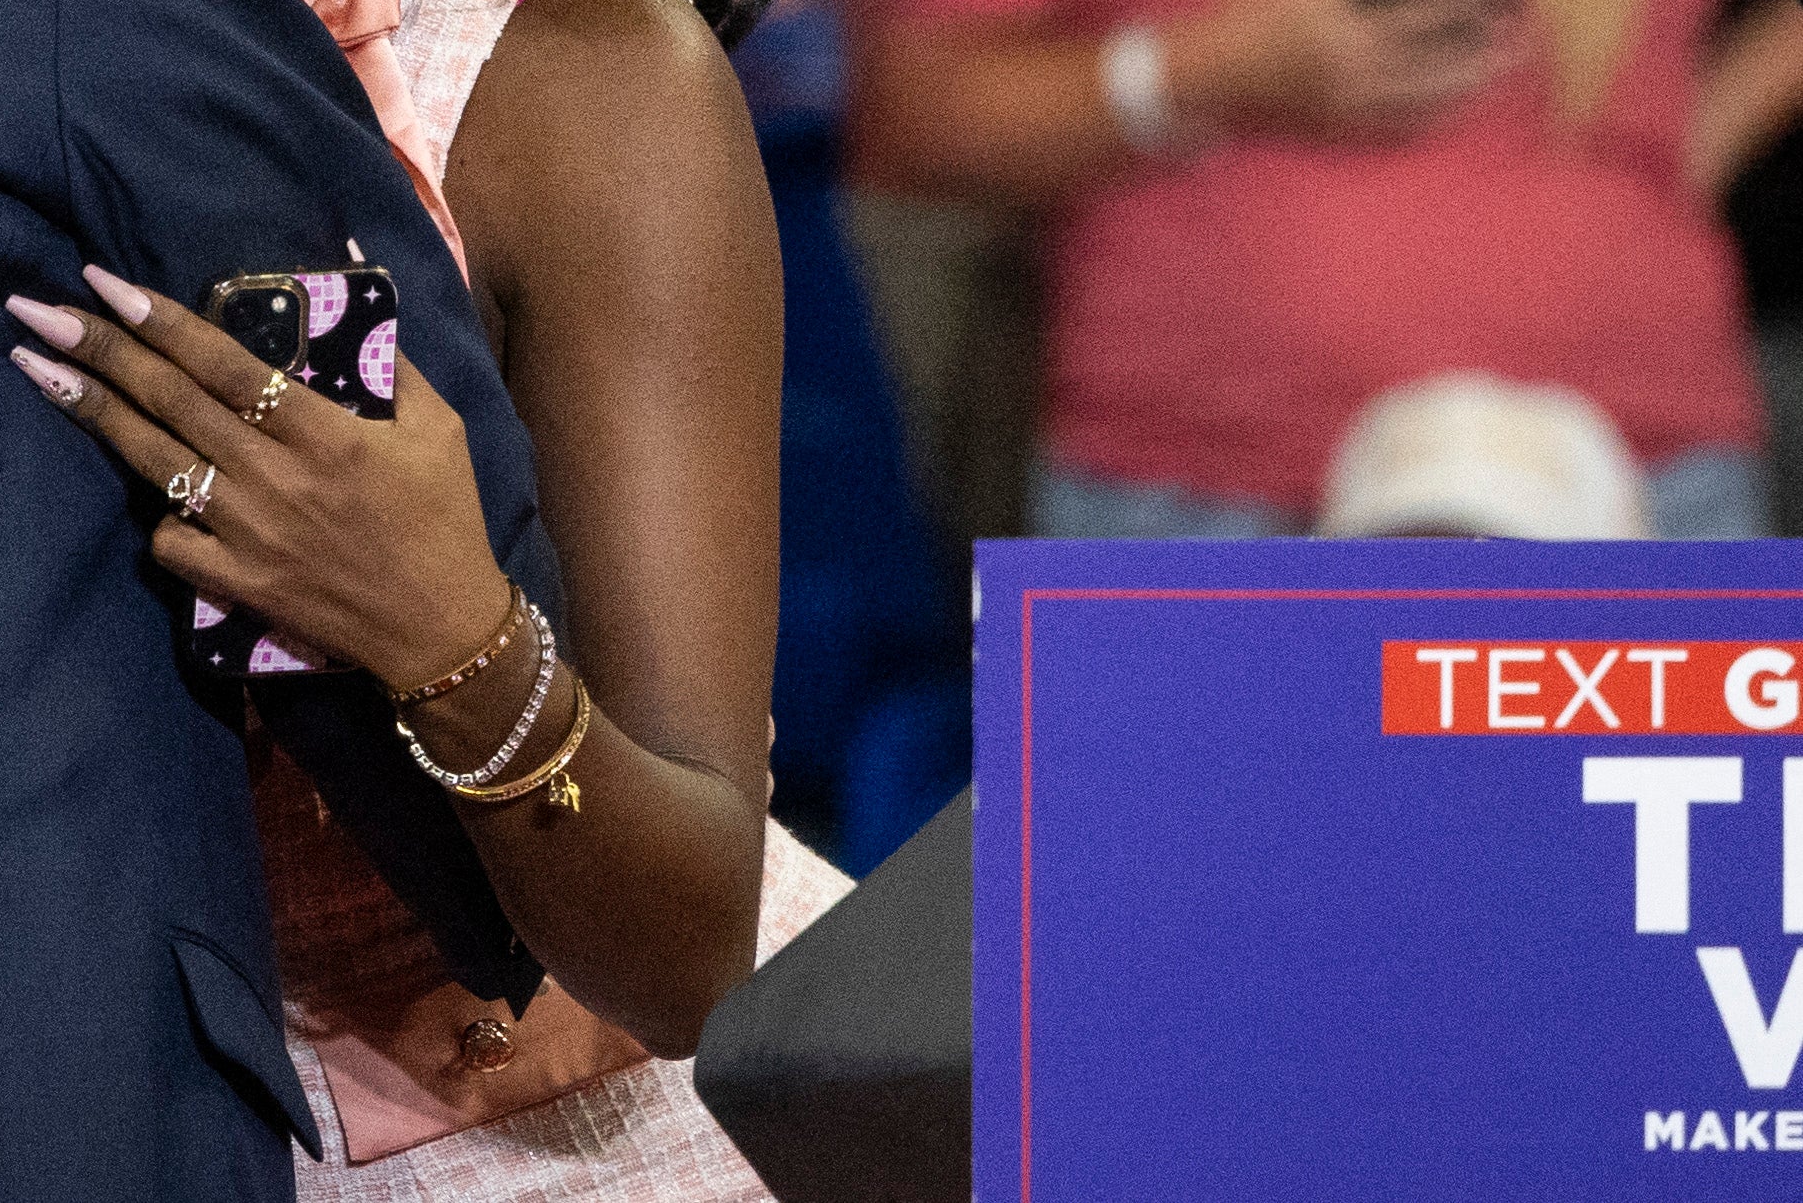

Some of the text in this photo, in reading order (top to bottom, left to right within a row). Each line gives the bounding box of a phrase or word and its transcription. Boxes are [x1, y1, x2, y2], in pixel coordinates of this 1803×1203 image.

[1416, 649, 1689, 729] TEXT
[1582, 757, 1803, 934] T
[1643, 1111, 1803, 1151] MAKE
